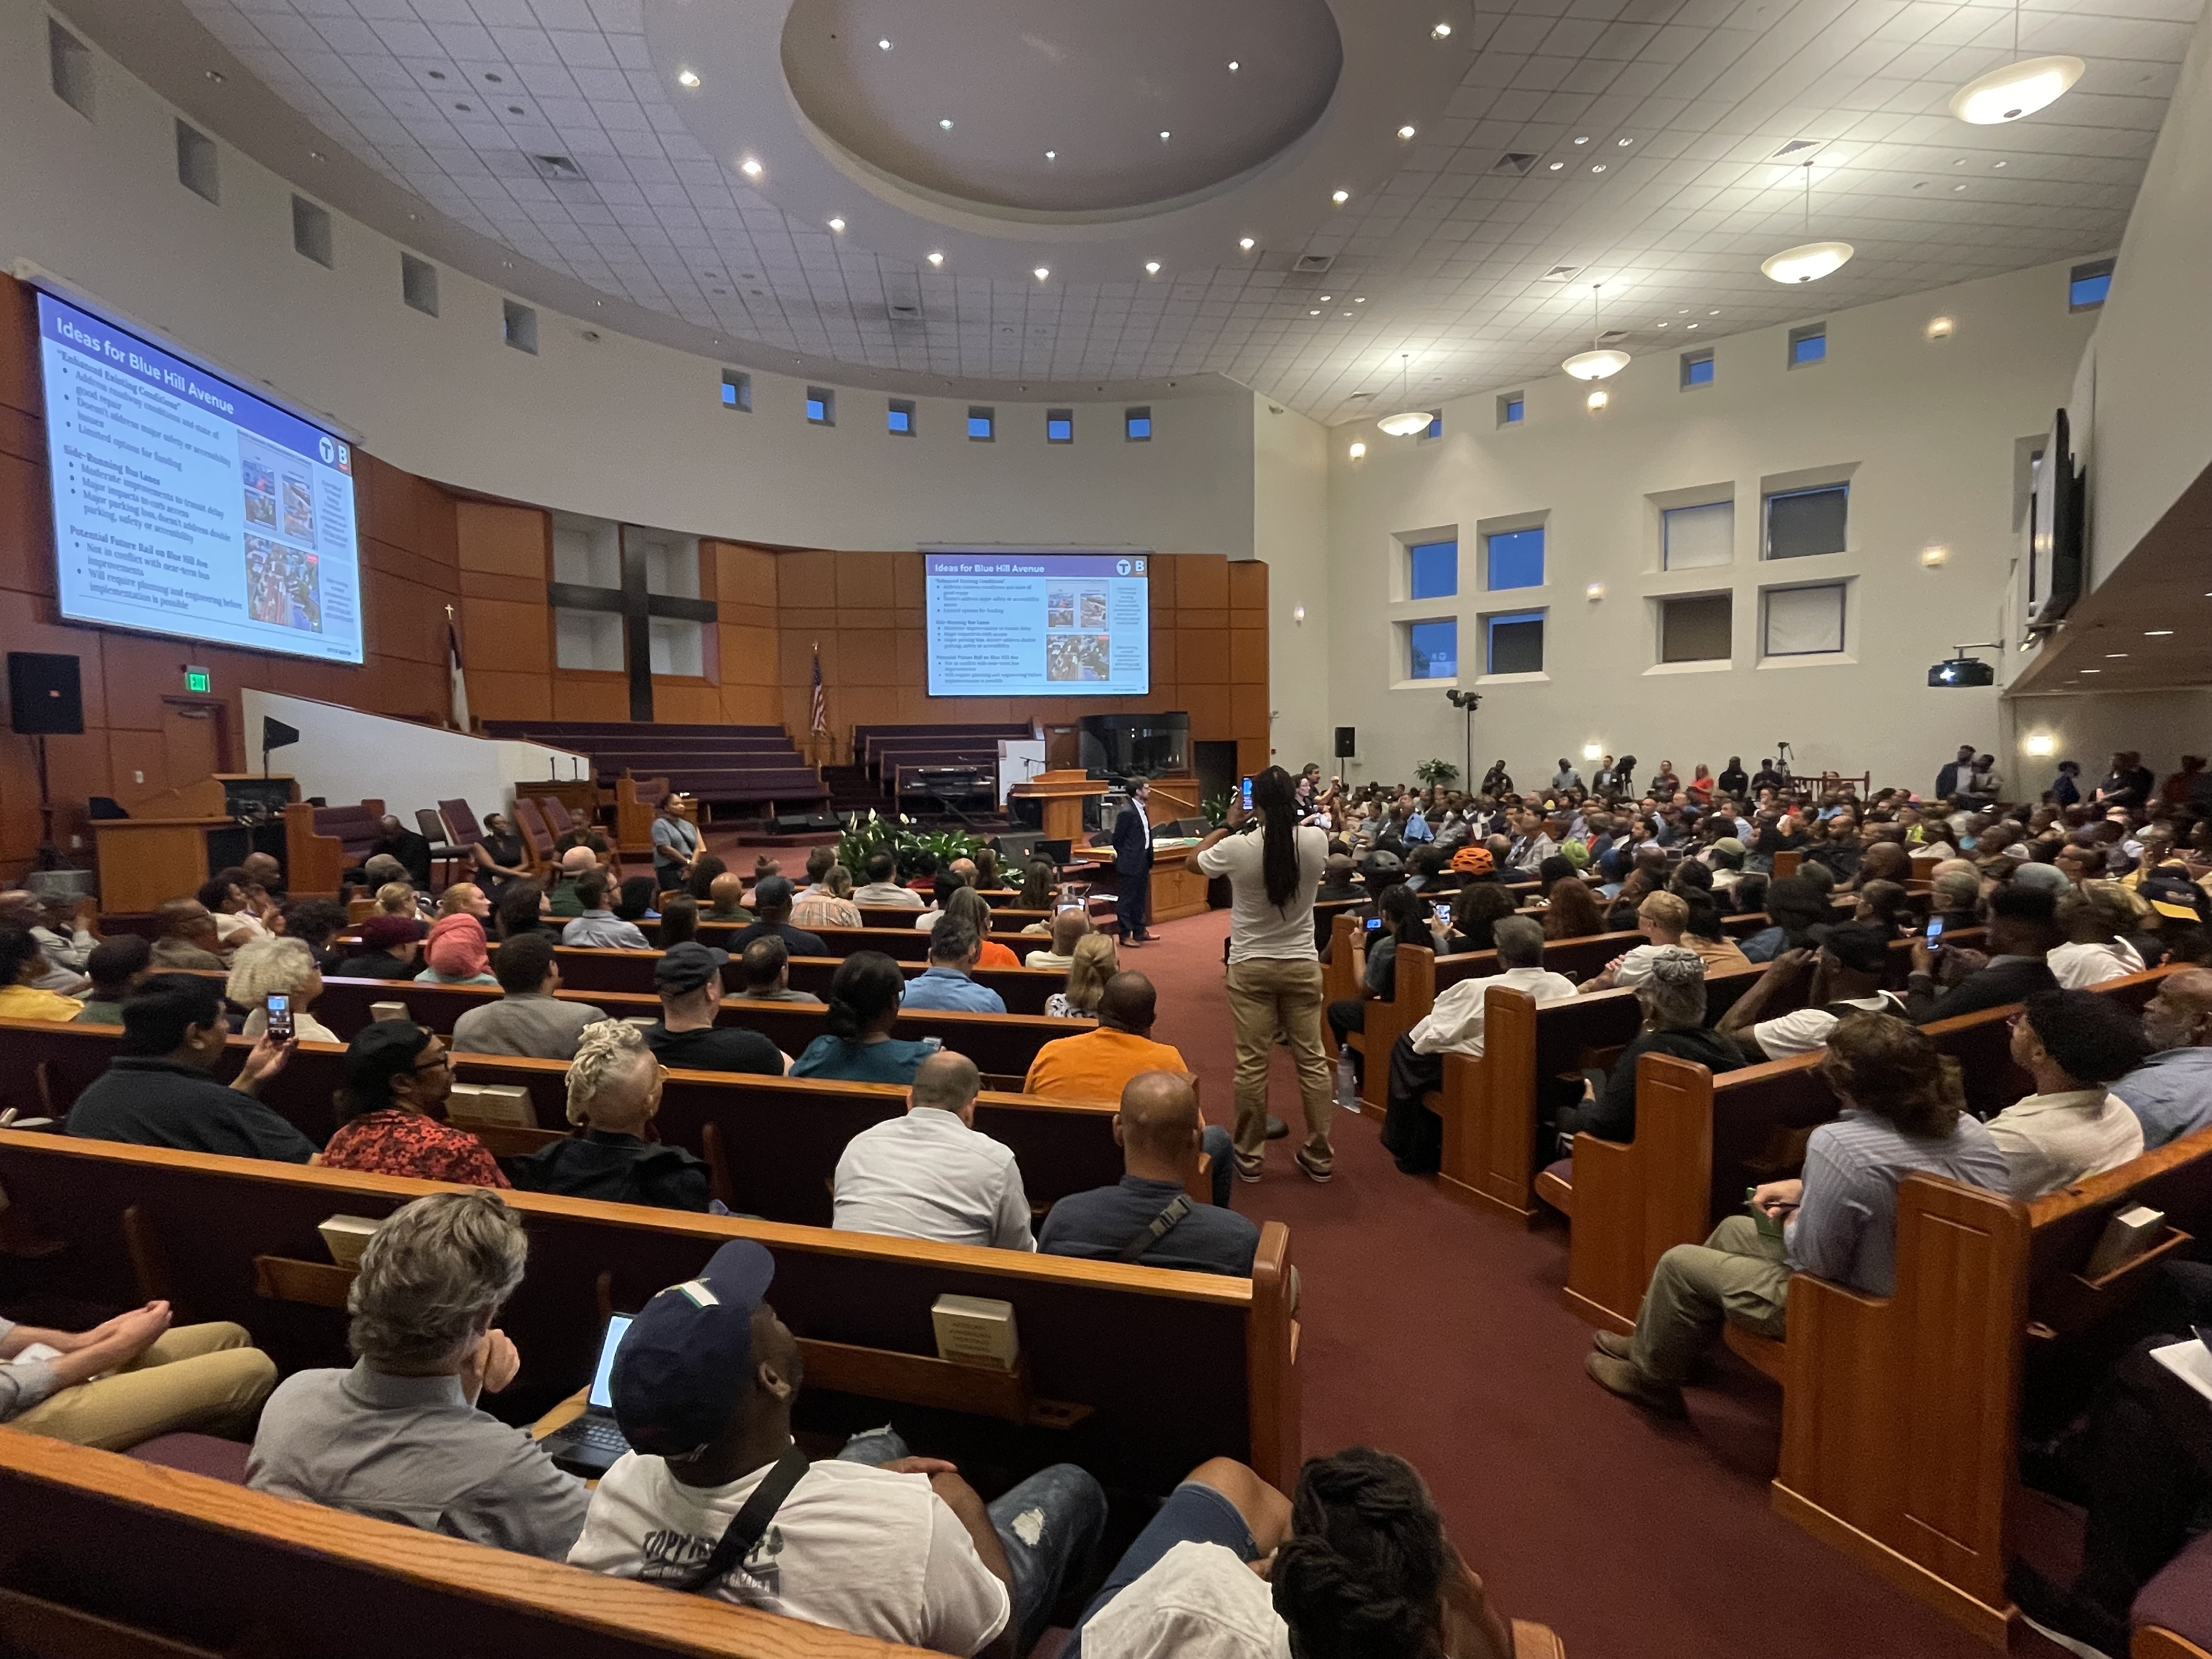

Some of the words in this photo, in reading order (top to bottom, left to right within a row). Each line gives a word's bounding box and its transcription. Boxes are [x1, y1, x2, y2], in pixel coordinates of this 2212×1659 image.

[57, 317, 101, 351] Ideas
[104, 340, 126, 363] for
[129, 352, 161, 380] Blue
[164, 369, 185, 392] Hill
[188, 382, 234, 415] Avenue
[337, 444, 348, 465] B
[935, 564, 958, 572] Ideas
[960, 564, 973, 572] for
[974, 564, 994, 573] Blue
[996, 565, 1010, 573] Hill
[1012, 565, 1045, 573] Avenue
[1135, 560, 1144, 572] B
